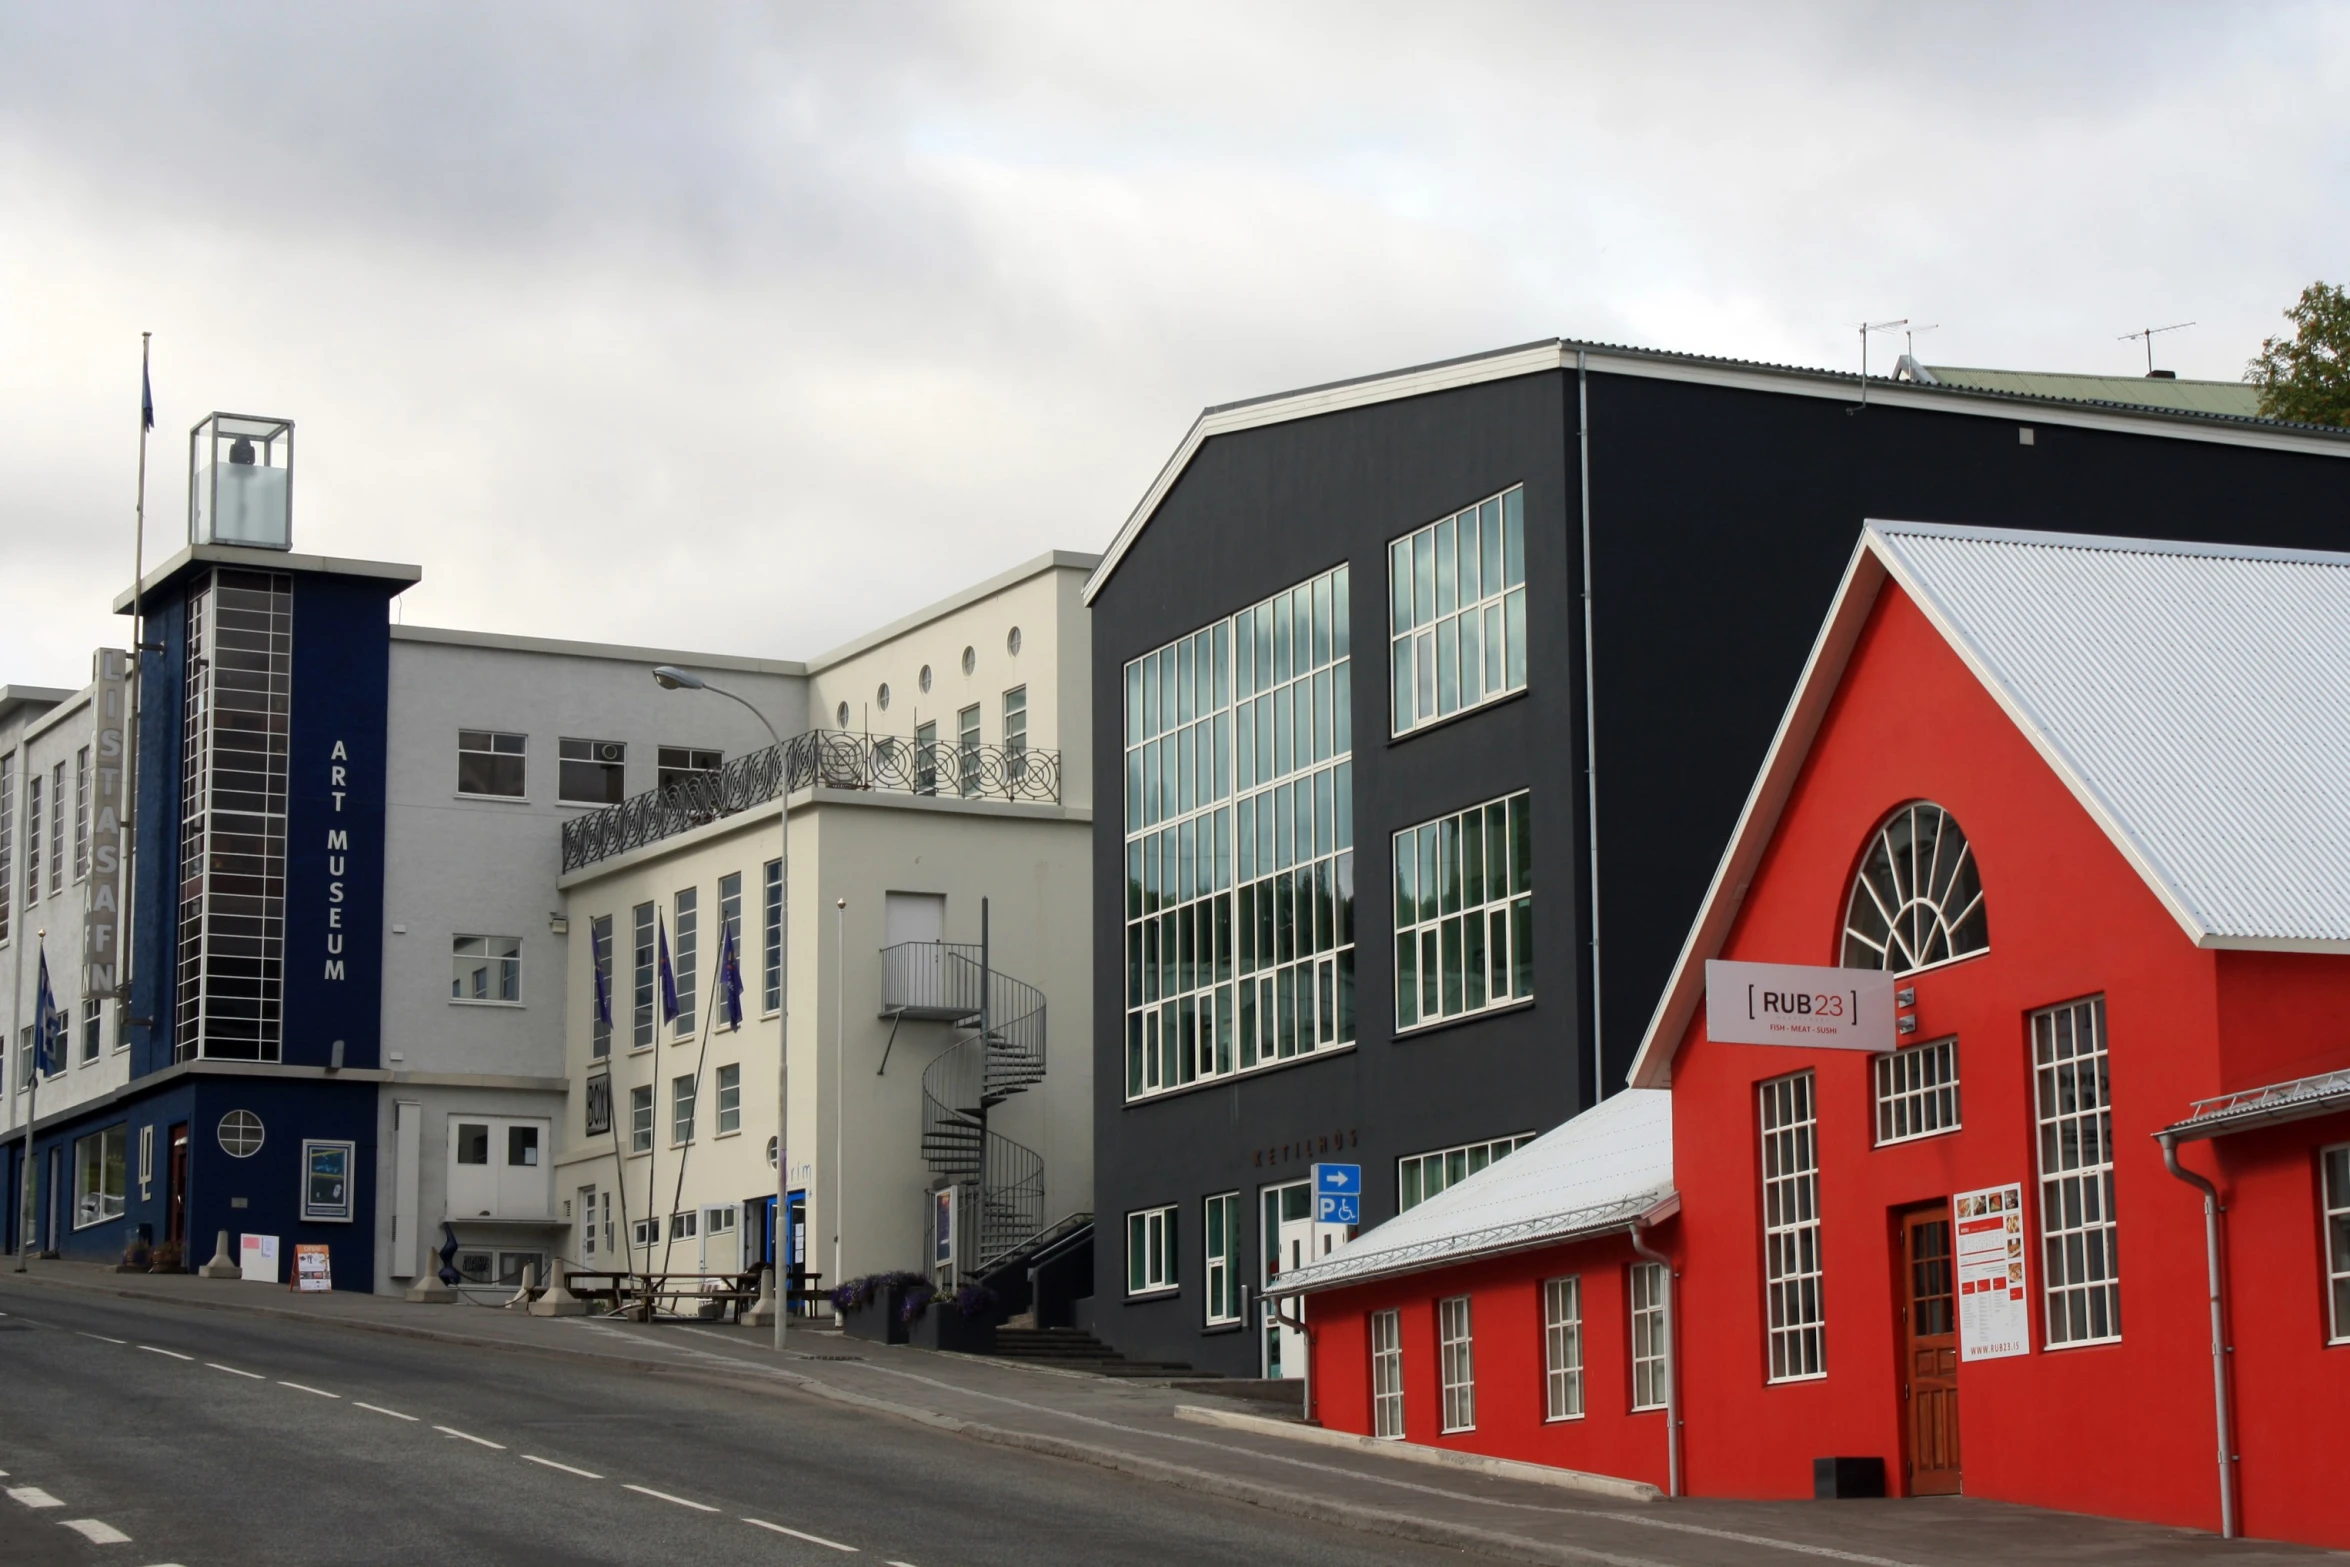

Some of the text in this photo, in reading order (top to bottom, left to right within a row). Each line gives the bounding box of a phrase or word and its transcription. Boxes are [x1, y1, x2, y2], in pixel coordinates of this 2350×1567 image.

[91, 651, 122, 992] LISTASAFN
[324, 740, 348, 981] ART MUSEUM
[1769, 1024, 1785, 1032] FISH
[1790, 1025, 1811, 1033] MEAT
[1816, 1026, 1838, 1035] SUSHI
[588, 1081, 606, 1127] BOX
[1319, 1198, 1336, 1220] P
[1970, 1341, 2020, 1356] WWW.RUB23.IS
